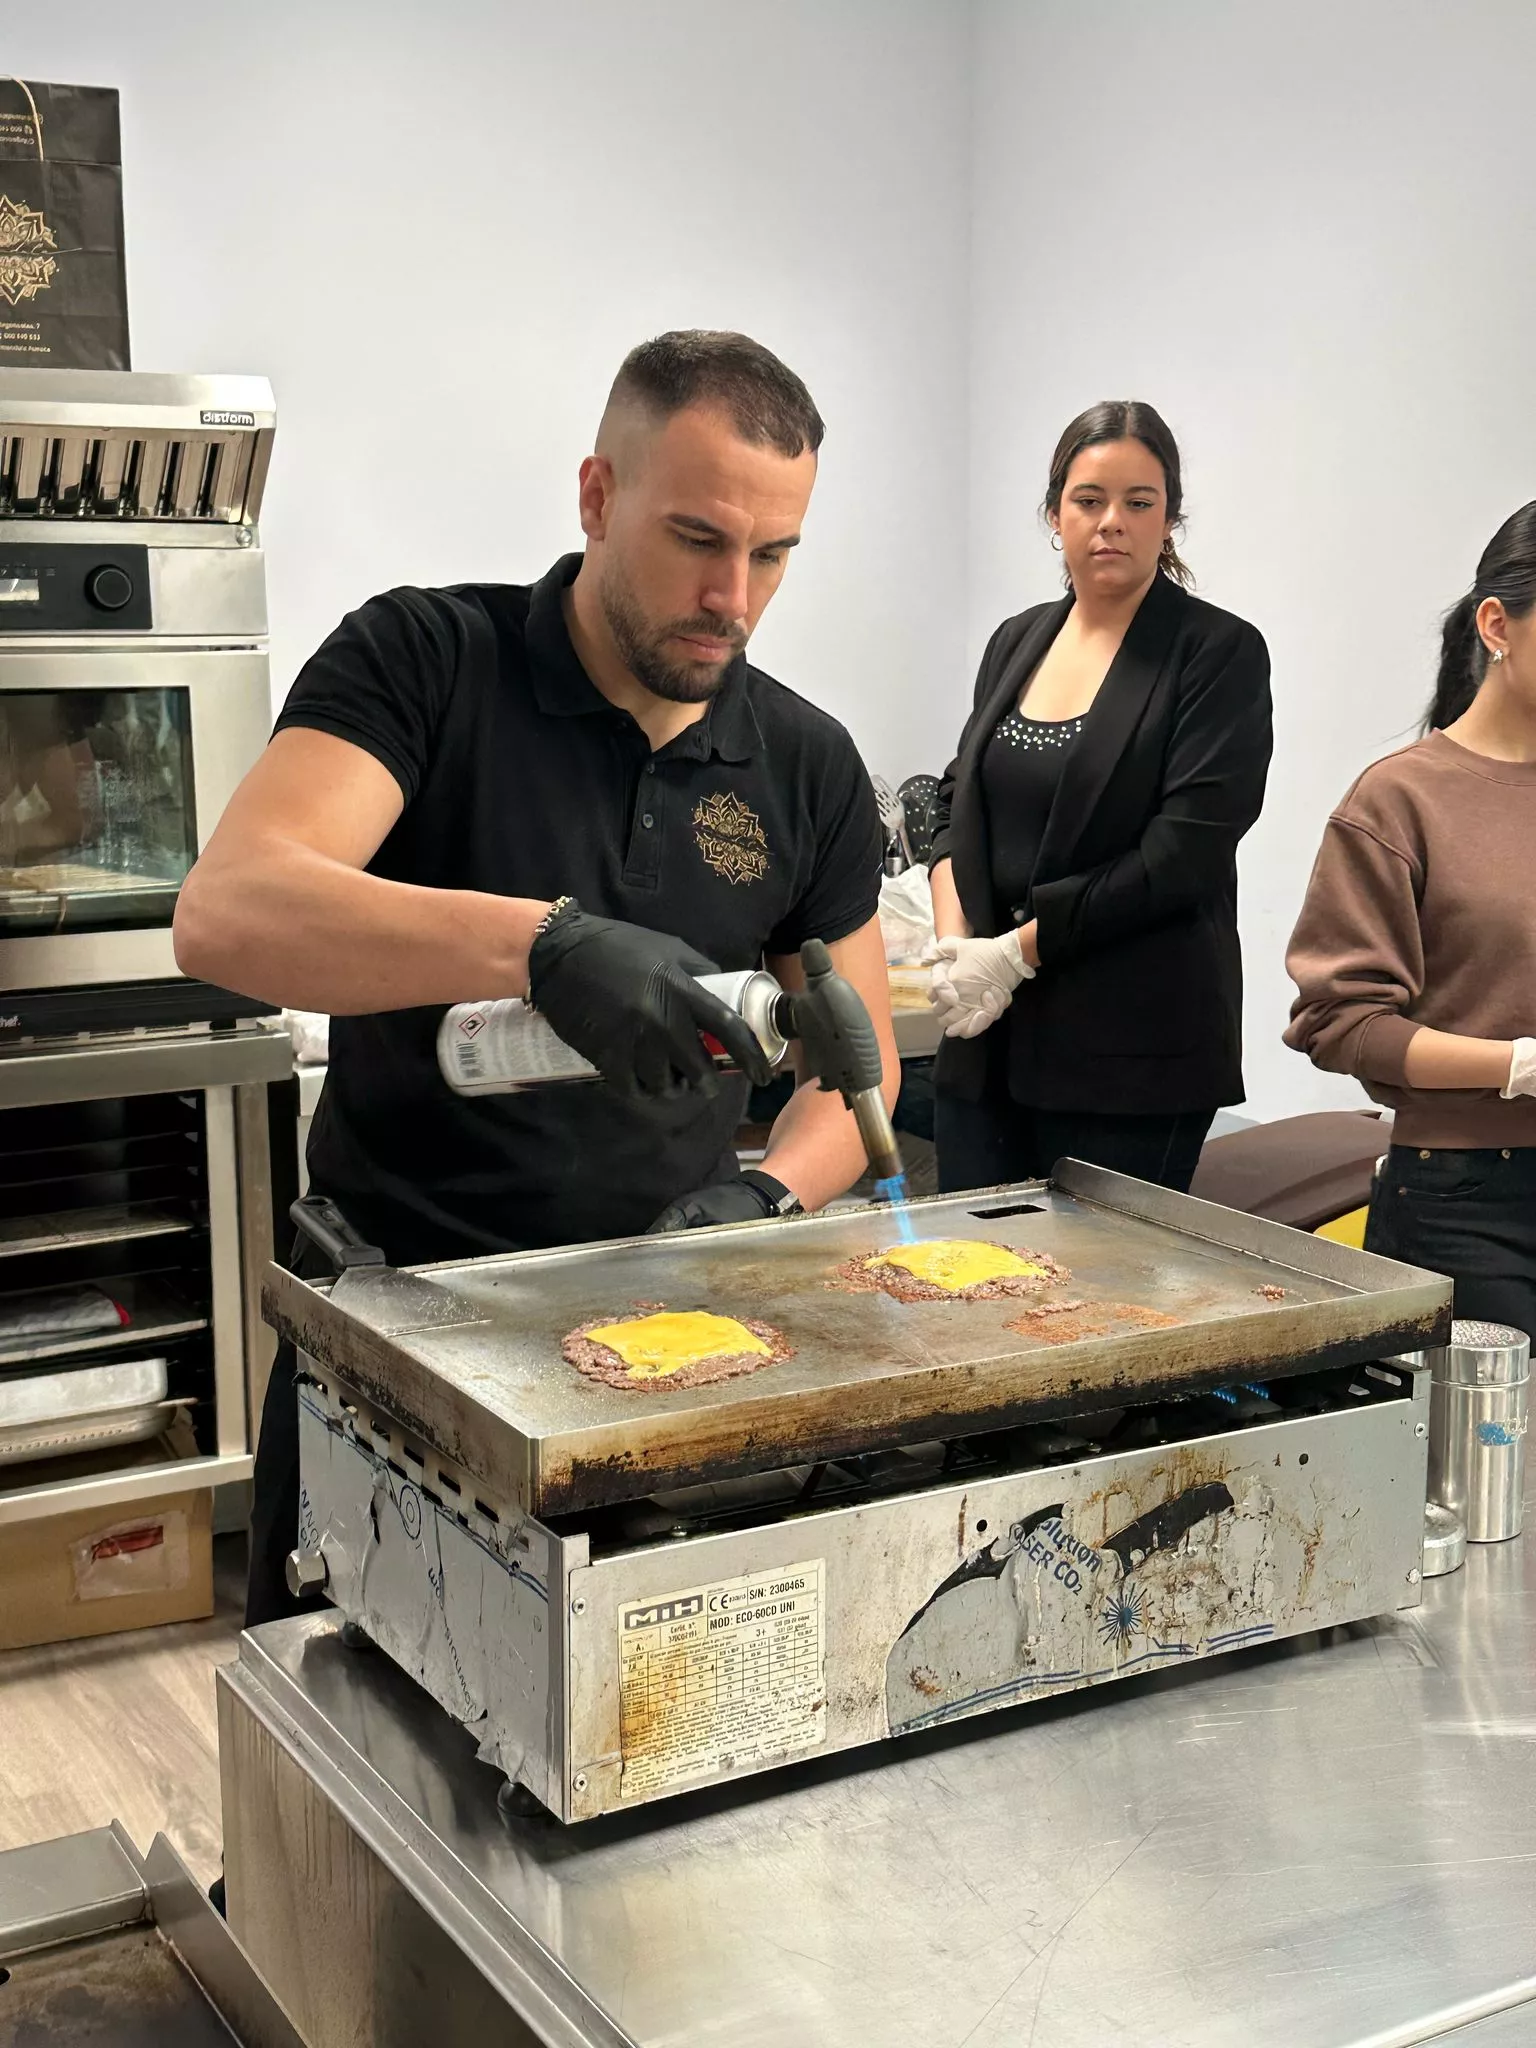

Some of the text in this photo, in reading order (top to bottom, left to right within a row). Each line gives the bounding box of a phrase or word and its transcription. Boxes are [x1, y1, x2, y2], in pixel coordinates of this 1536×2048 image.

[749, 1588, 767, 1600] S/N:
[769, 1578, 805, 1595] 2300465
[710, 1616, 733, 1630] MOD:
[735, 1605, 777, 1624] ECO-60CD
[780, 1600, 795, 1614] UNI
